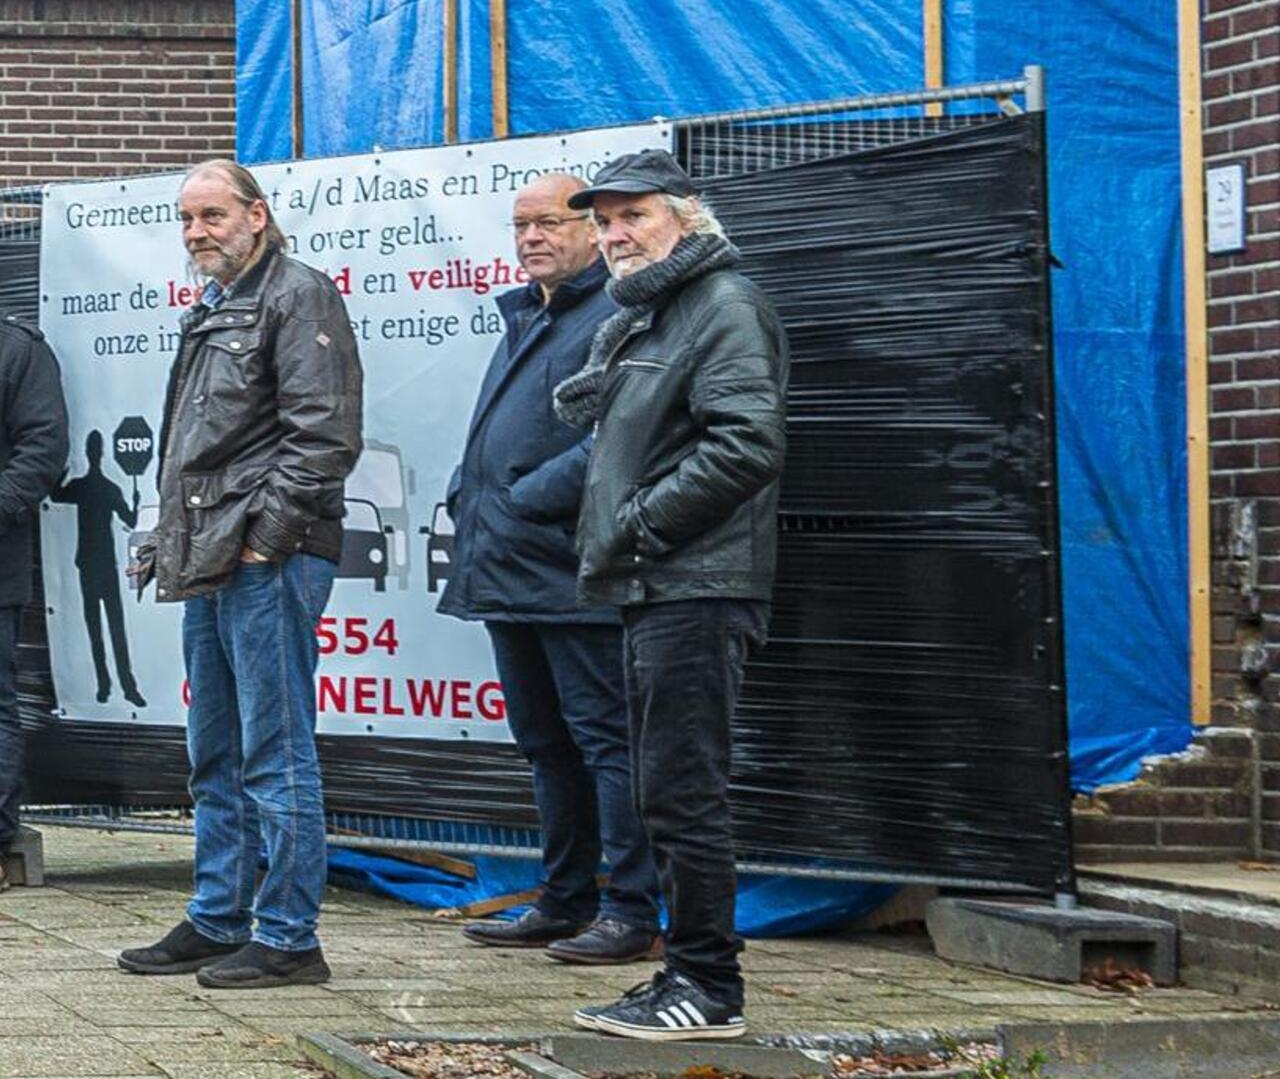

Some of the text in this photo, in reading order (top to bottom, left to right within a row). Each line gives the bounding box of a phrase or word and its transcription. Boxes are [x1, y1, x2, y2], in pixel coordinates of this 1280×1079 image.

[65, 201, 183, 229] Gemeent
[288, 177, 342, 215] a/d
[353, 173, 429, 204] Maas
[442, 175, 479, 196] en
[310, 228, 372, 253] over
[381, 215, 464, 256] geld...
[61, 292, 121, 316] maar
[129, 282, 159, 310] de
[363, 272, 397, 294] en
[408, 256, 528, 295] veilighe
[94, 332, 149, 356] onze
[381, 308, 459, 345] enige
[116, 437, 152, 452] STOP
[317, 675, 506, 721] NELWEG
